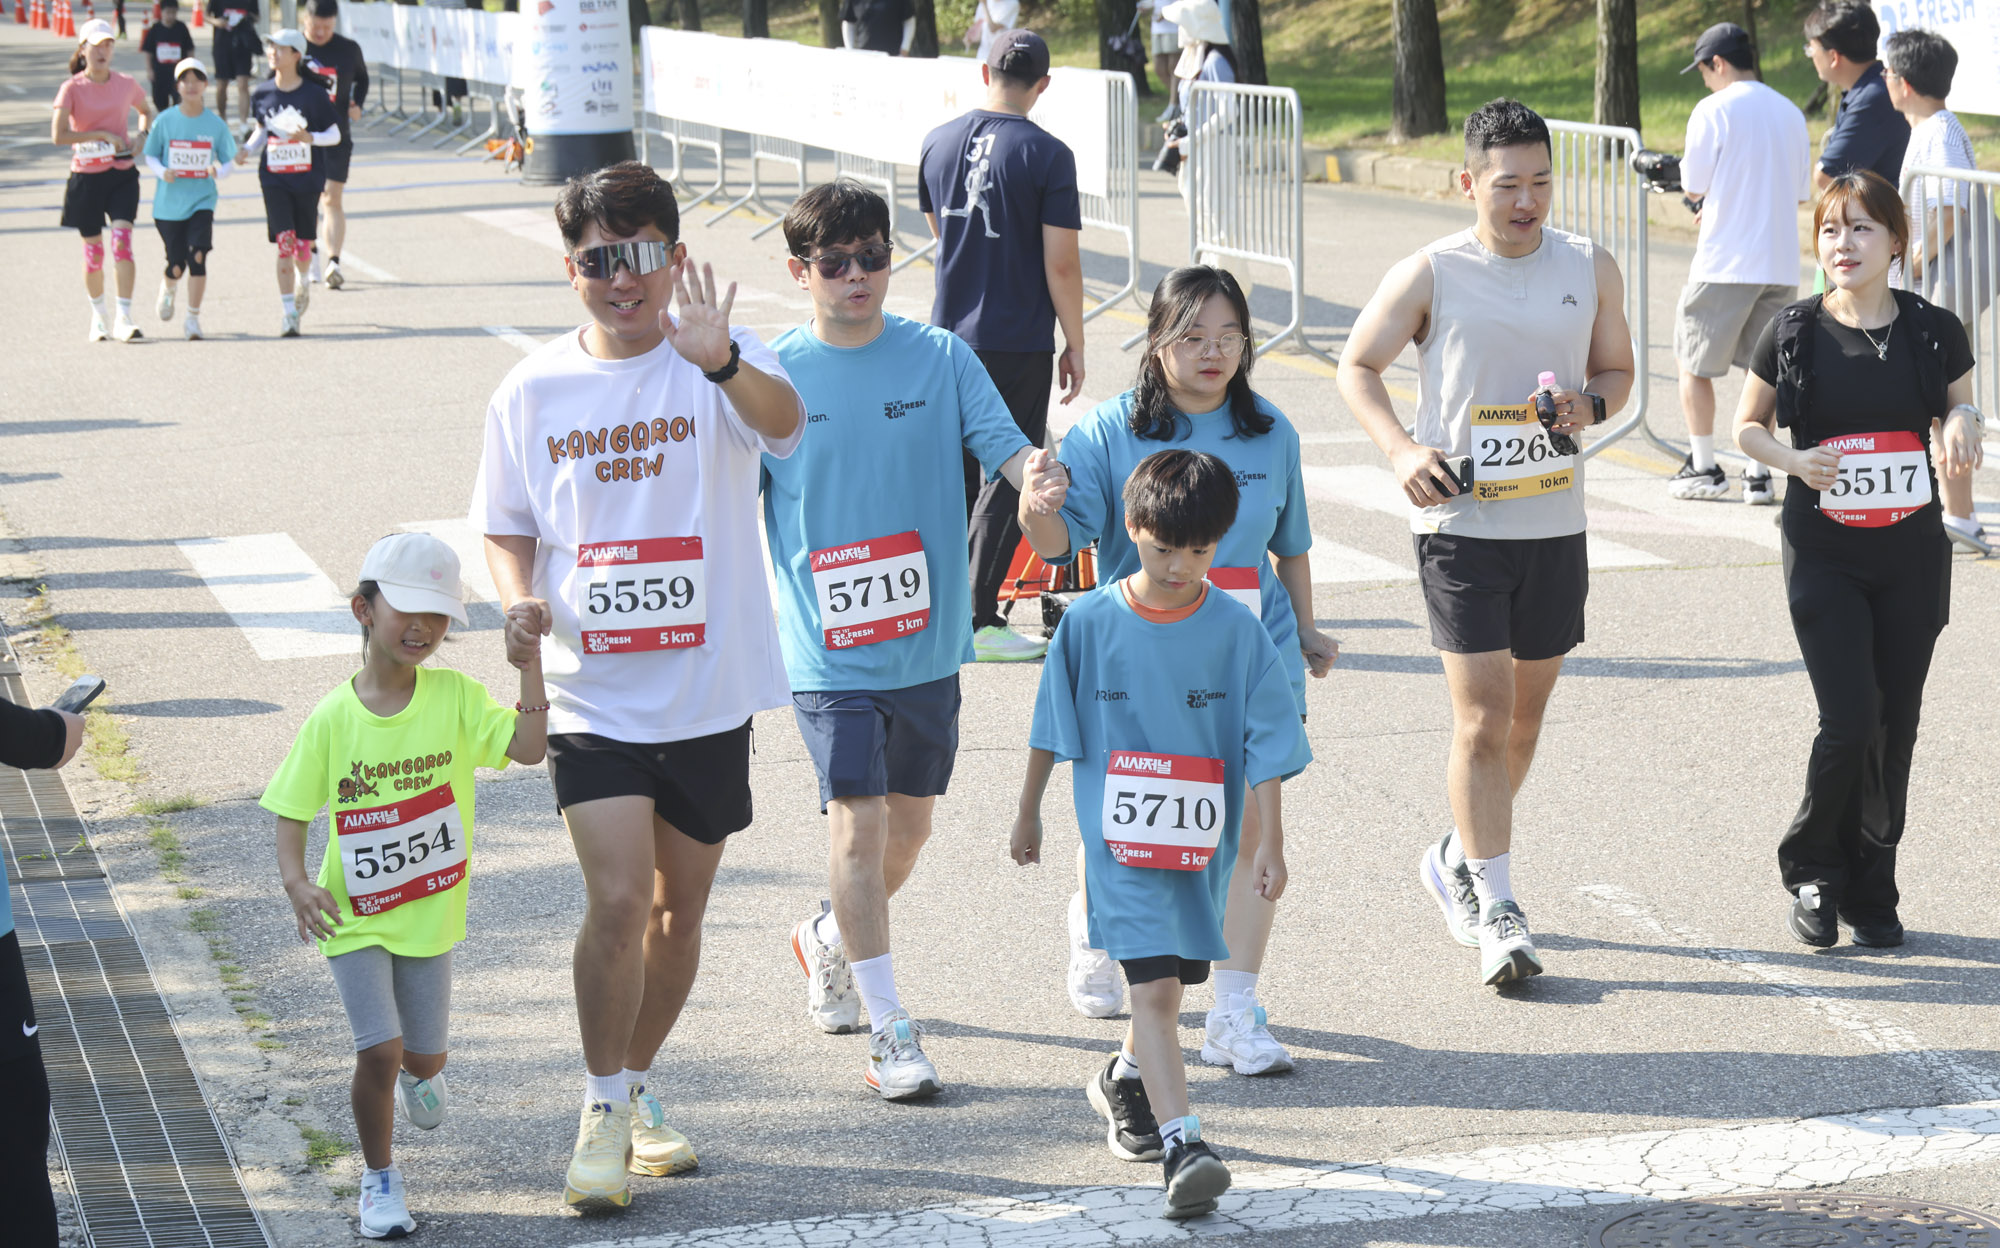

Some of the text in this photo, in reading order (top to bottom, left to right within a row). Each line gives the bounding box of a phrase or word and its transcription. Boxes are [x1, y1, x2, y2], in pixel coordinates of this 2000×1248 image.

[173, 152, 207, 165] 5207
[808, 413, 830, 423] ian.
[1478, 409, 1527, 421] 시사저널
[547, 415, 696, 464] KANGARO
[595, 453, 664, 482] CREW
[1540, 476, 1569, 489] 10 km
[1830, 464, 1918, 497] 5517
[1890, 512, 1898, 521] 5
[585, 545, 638, 560] 시사저널
[818, 545, 871, 565] 시사저널
[588, 576, 695, 614] 5559
[828, 567, 921, 612] 5719
[896, 617, 923, 632] 5 km
[660, 631, 696, 644] 5 km
[364, 750, 452, 780] KANGAROO
[1114, 756, 1171, 774] 시사저널
[394, 774, 433, 791] CREW
[344, 808, 400, 828] 시사저널
[1112, 791, 1217, 831] 5710
[354, 822, 456, 879] 5554
[1181, 853, 1209, 865] 5 km
[427, 871, 459, 891] 5 km
